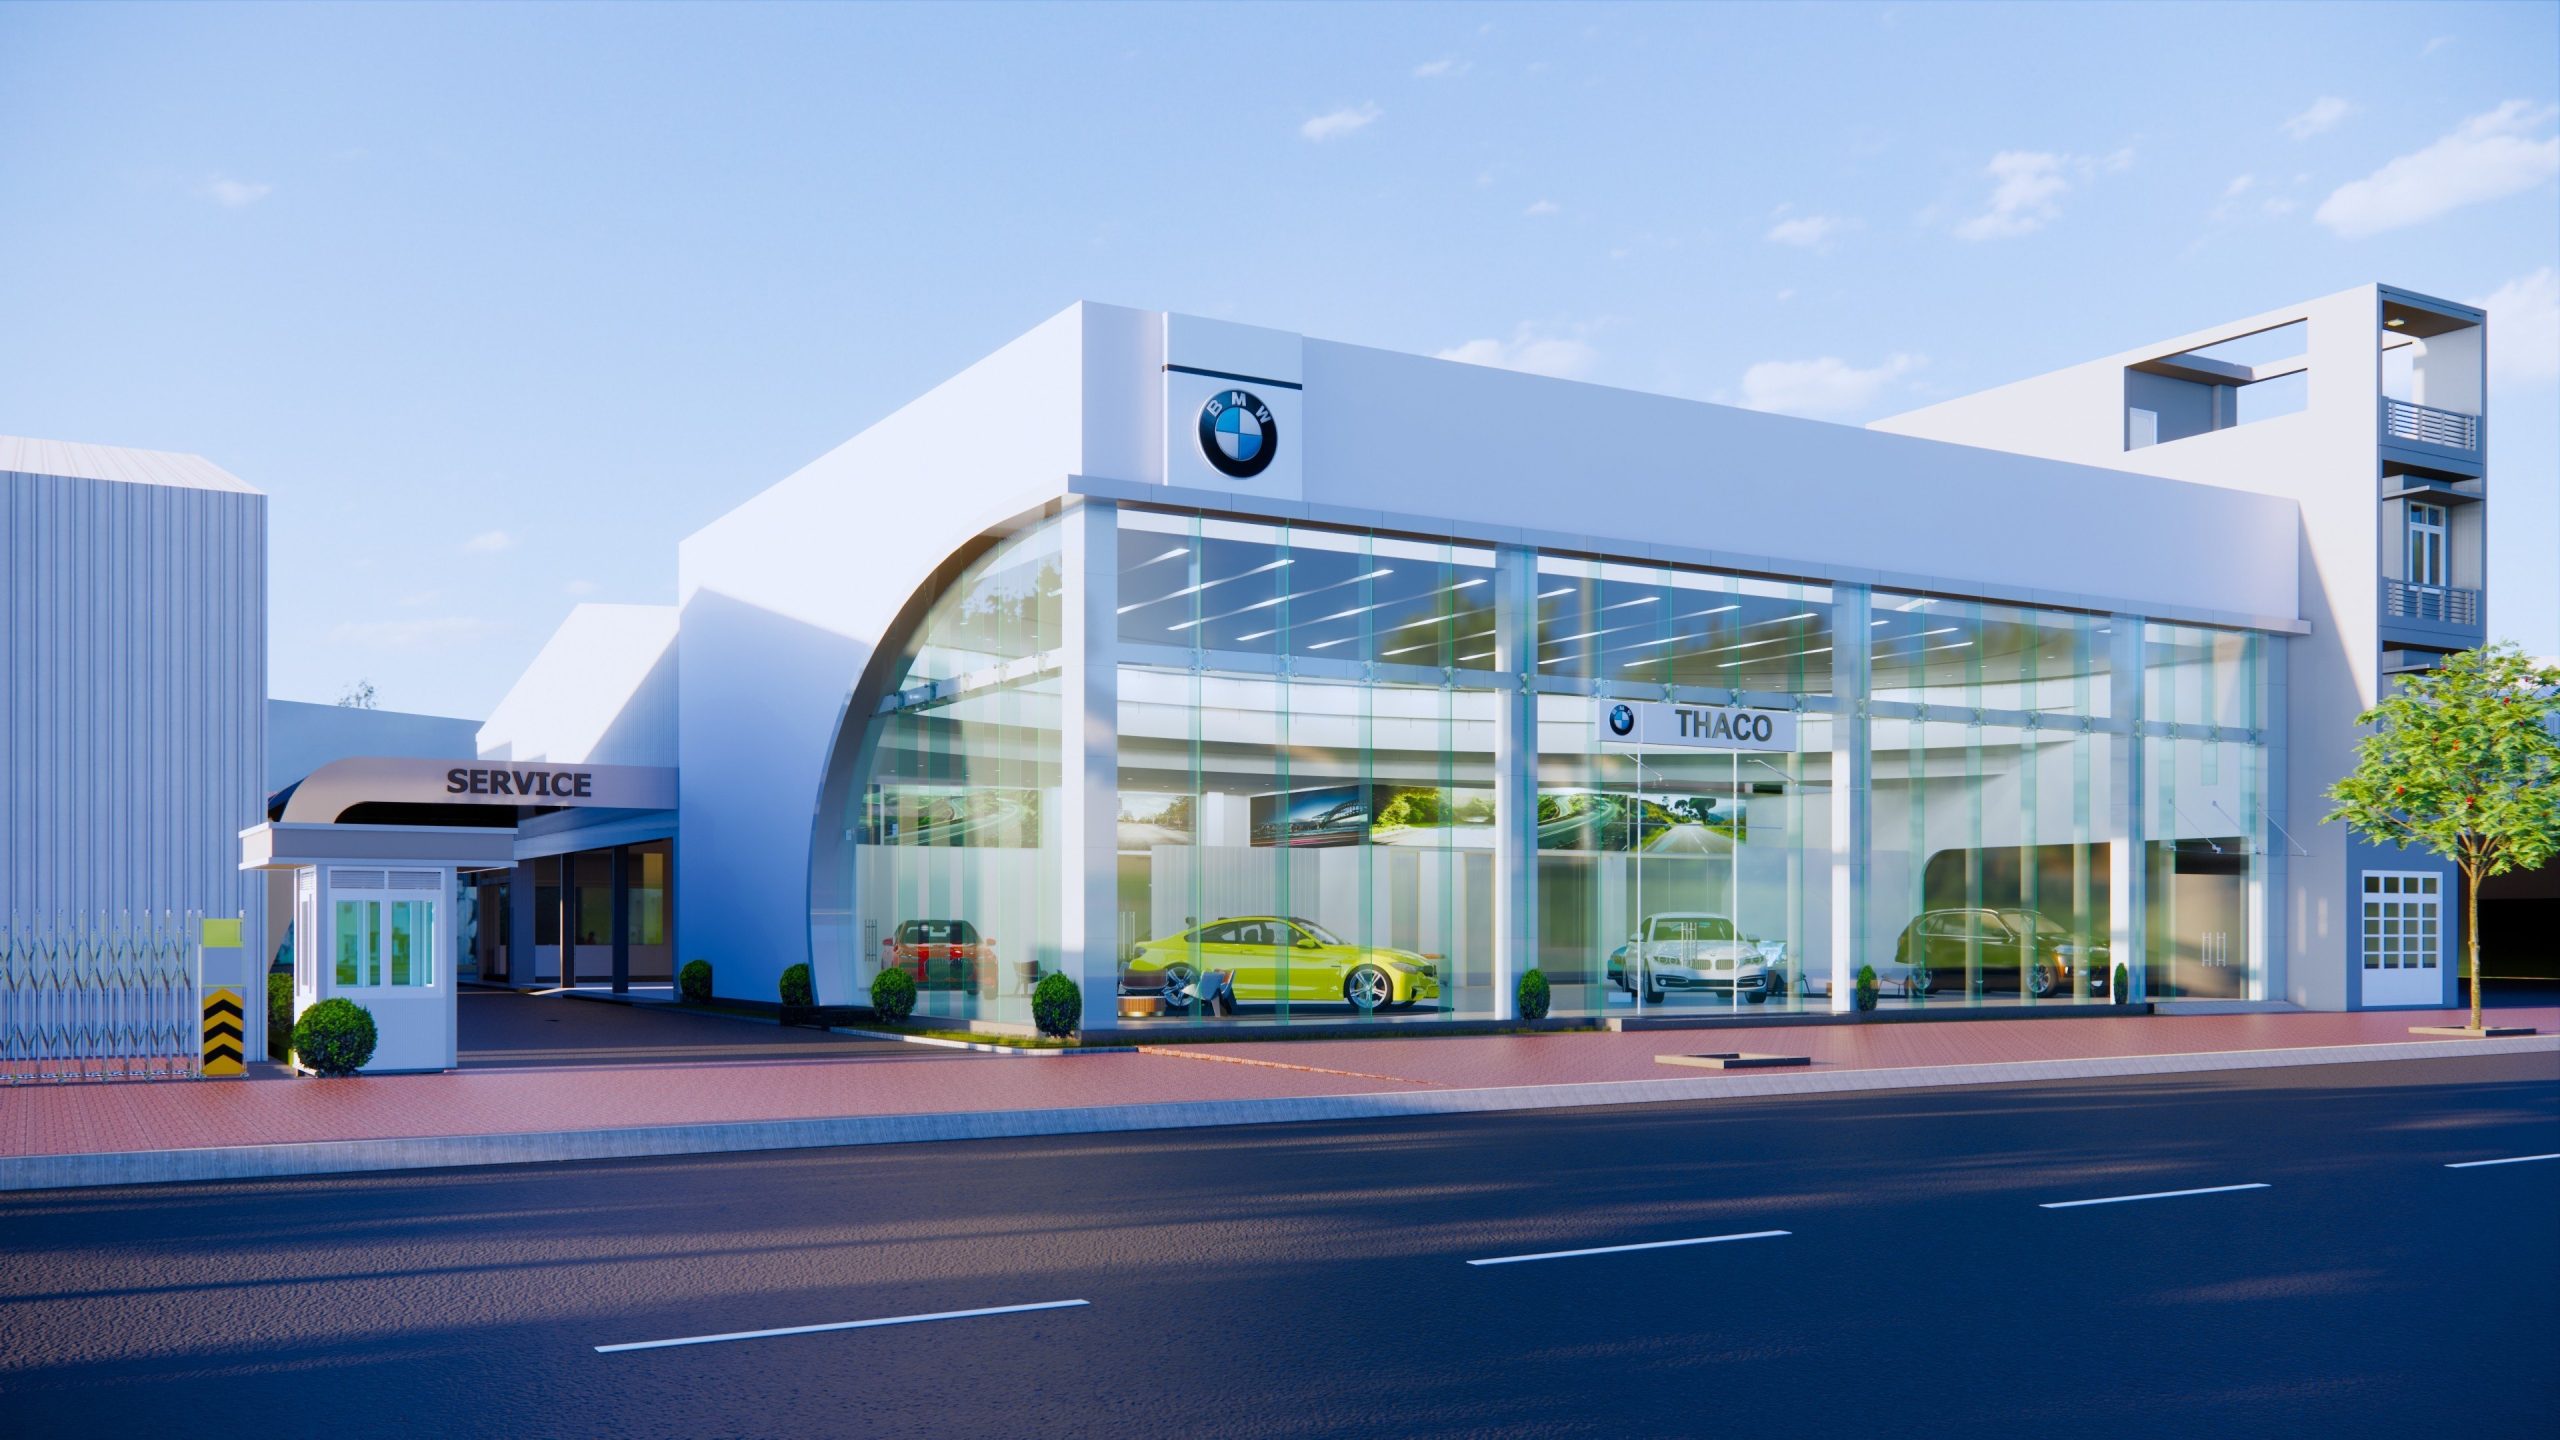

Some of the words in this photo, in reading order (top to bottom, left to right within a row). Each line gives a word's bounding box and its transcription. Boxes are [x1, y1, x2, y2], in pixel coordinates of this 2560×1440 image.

[1207, 392, 1272, 424] BMW
[1675, 709, 1772, 742] THACO
[447, 768, 592, 797] SERVICE
